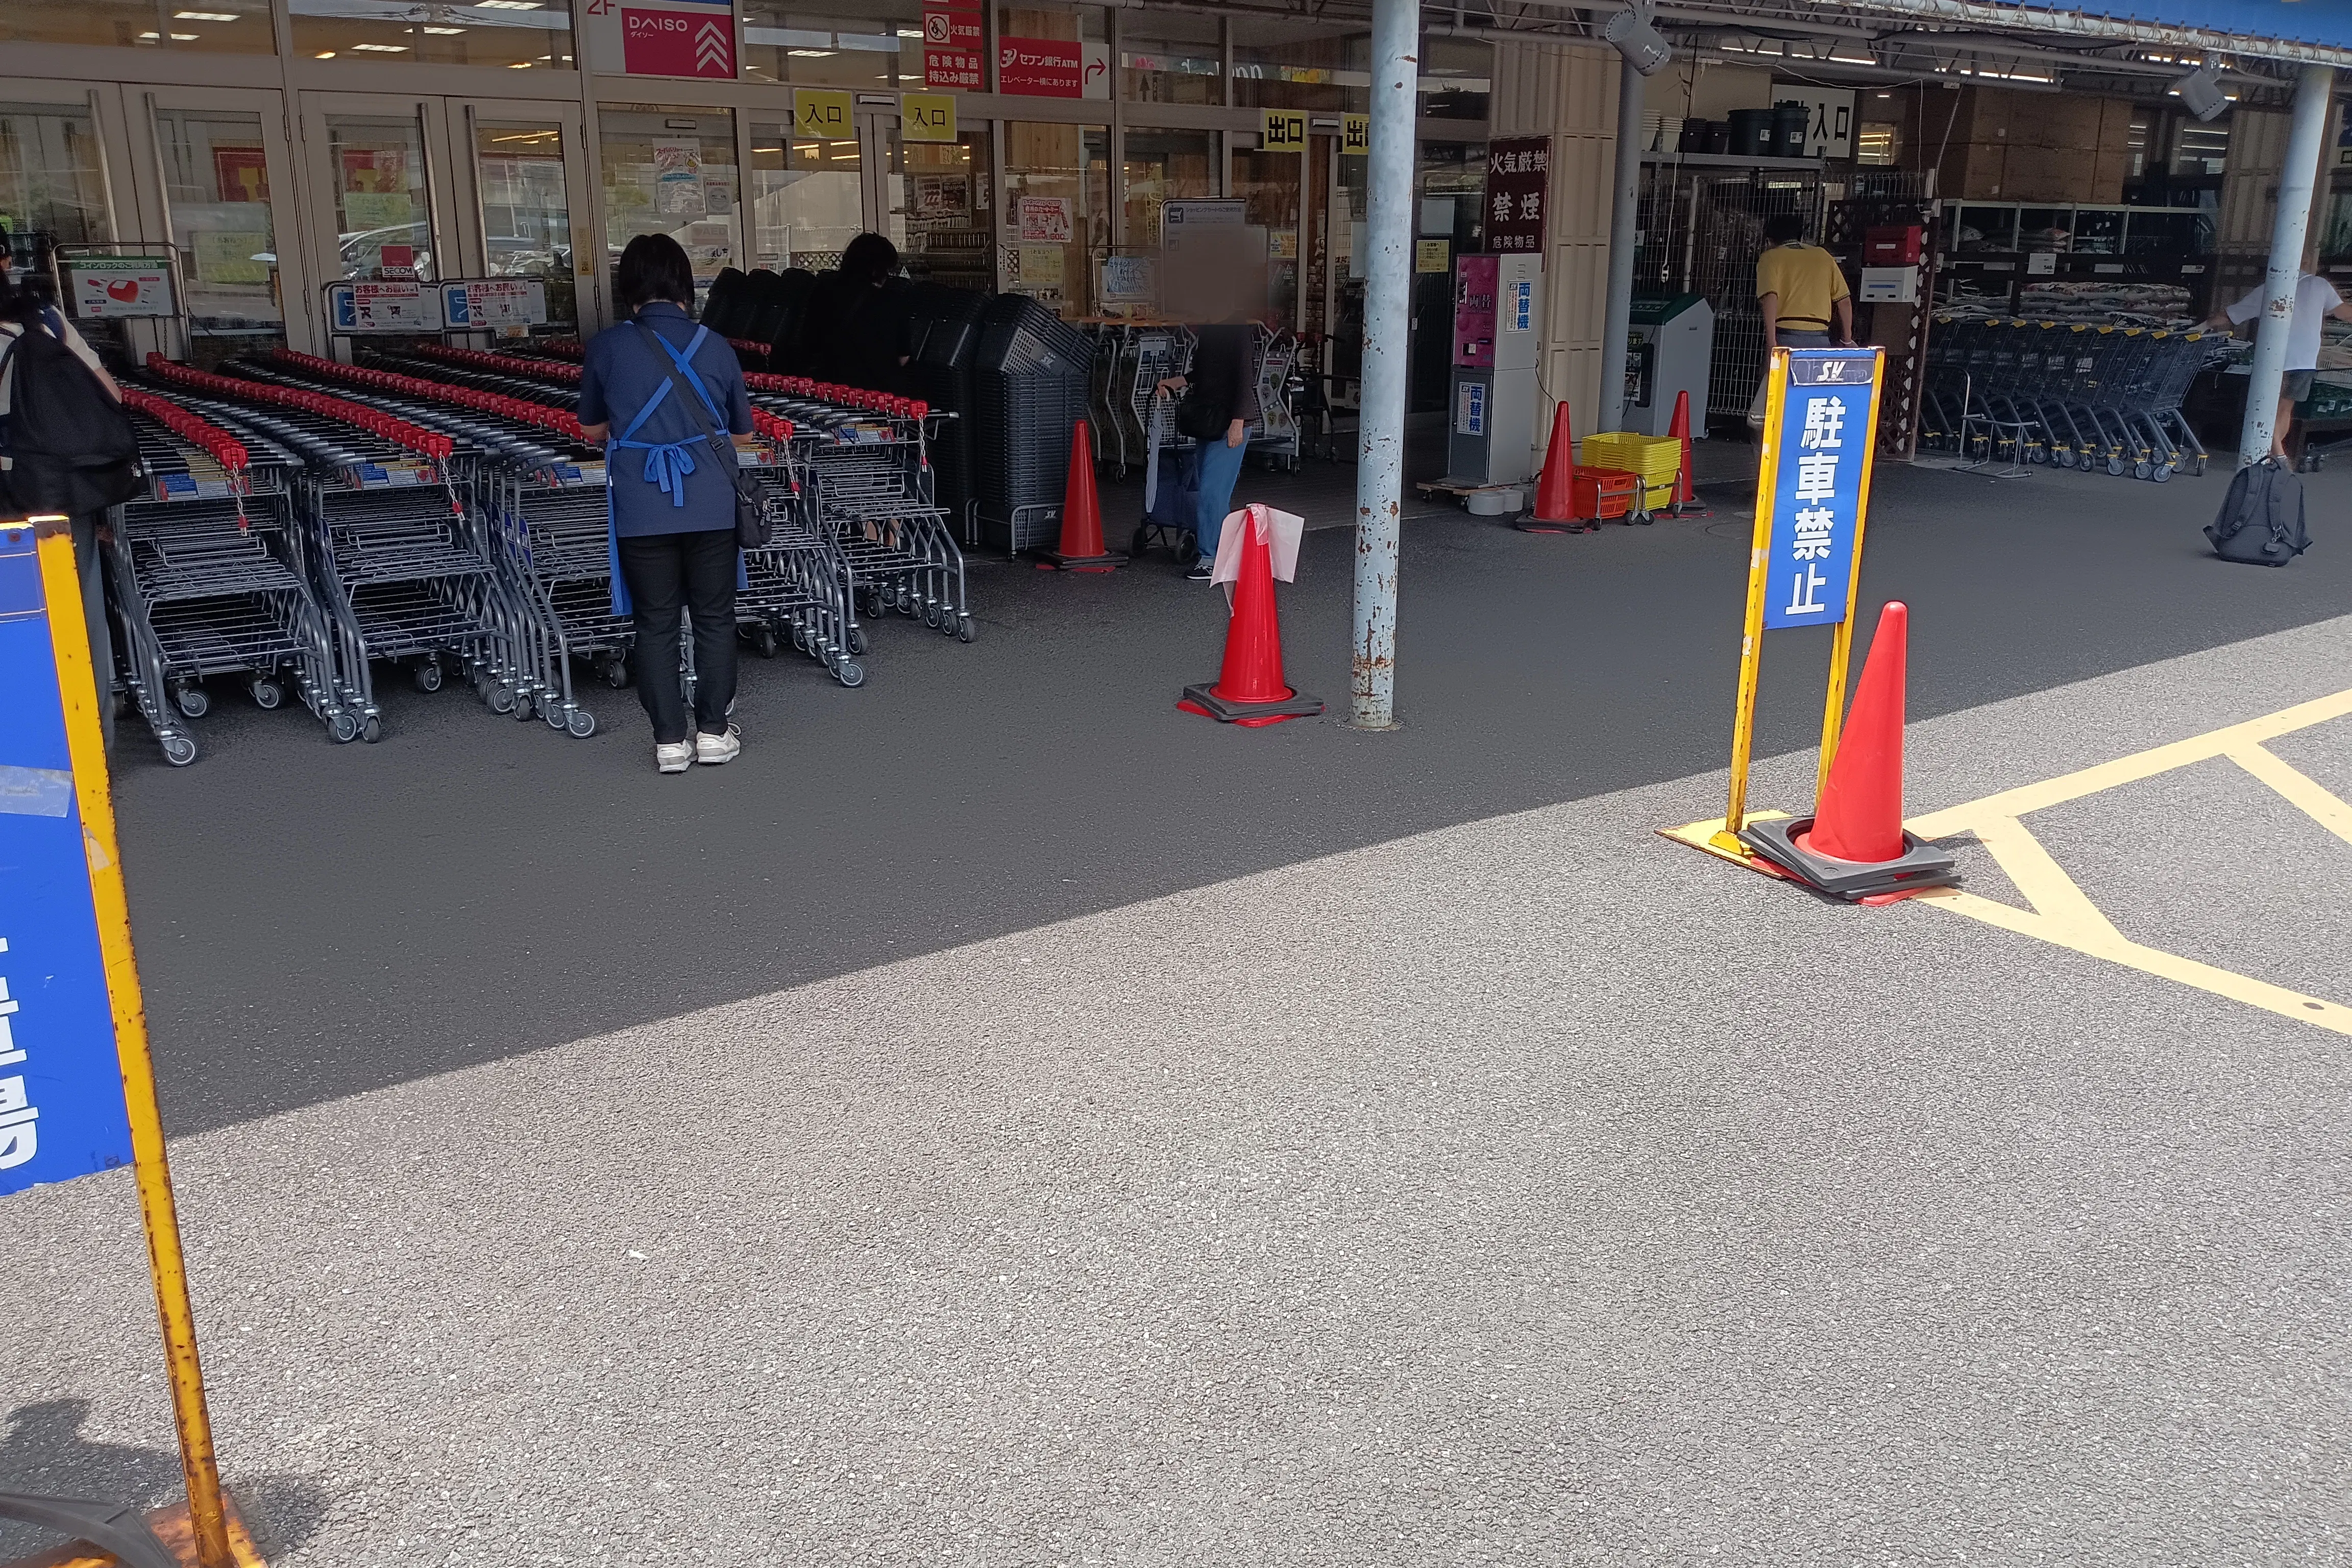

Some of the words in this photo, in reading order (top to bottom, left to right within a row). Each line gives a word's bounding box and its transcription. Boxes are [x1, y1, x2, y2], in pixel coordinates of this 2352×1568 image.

[628, 16, 688, 32] DAISO
[950, 24, 981, 37] 火気厳禁
[928, 54, 978, 70] 危険物品
[929, 70, 979, 85] 持込み厳禁
[1000, 76, 1078, 87] エレベーター横にあります
[804, 103, 842, 124] 入口
[912, 107, 945, 127] 入口
[1812, 103, 1850, 141] 入口
[1268, 115, 1303, 144] 出口
[1346, 120, 1369, 148] 出
[1489, 150, 1547, 176] 火気厳禁
[1492, 191, 1540, 222] 禁煙
[1492, 235, 1535, 249] 危険物品
[1469, 294, 1491, 308] 両替
[1517, 282, 1531, 330] 両替機
[1816, 361, 1846, 382] SV
[1469, 386, 1483, 432] 両替機
[1785, 395, 1847, 616] 駐車禁止
